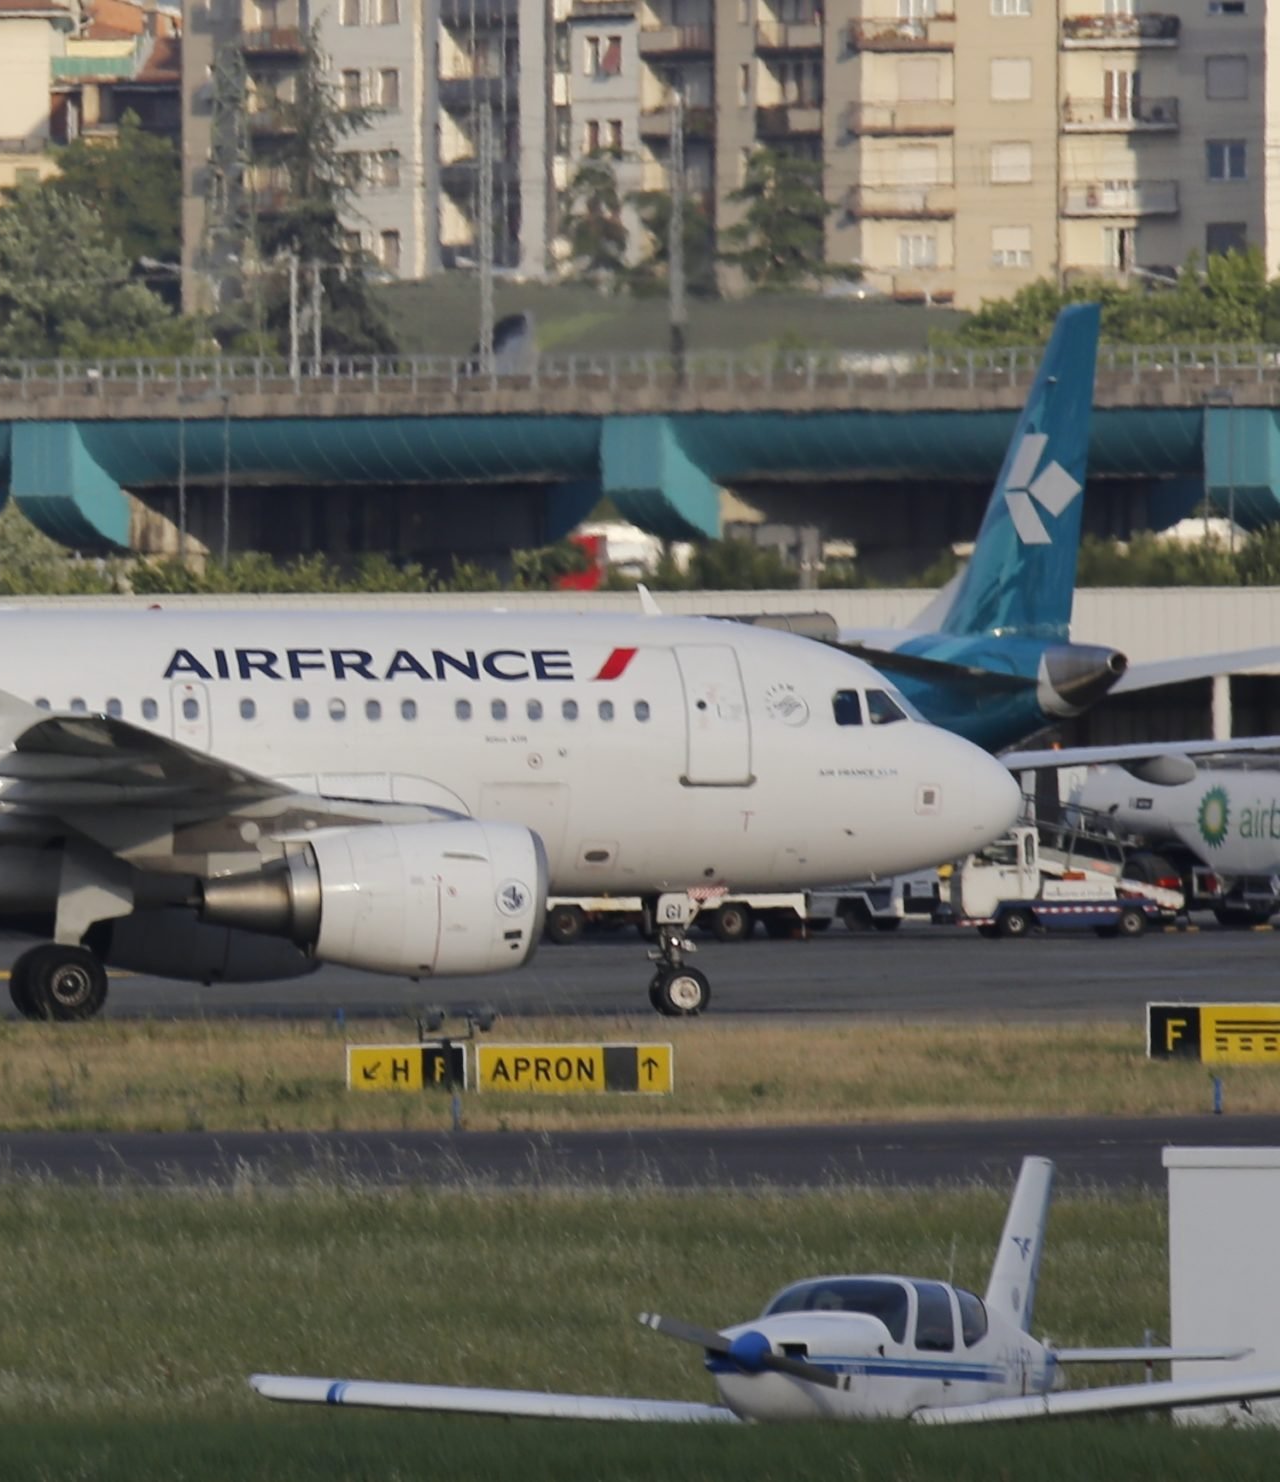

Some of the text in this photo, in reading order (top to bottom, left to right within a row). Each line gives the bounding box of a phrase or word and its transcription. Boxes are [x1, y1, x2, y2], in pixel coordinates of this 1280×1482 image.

[162, 648, 575, 681] AIRFRANCE
[665, 903, 682, 920] GI
[1166, 1018, 1187, 1051] F
[391, 1058, 410, 1082] H
[491, 1056, 596, 1083] APRON
